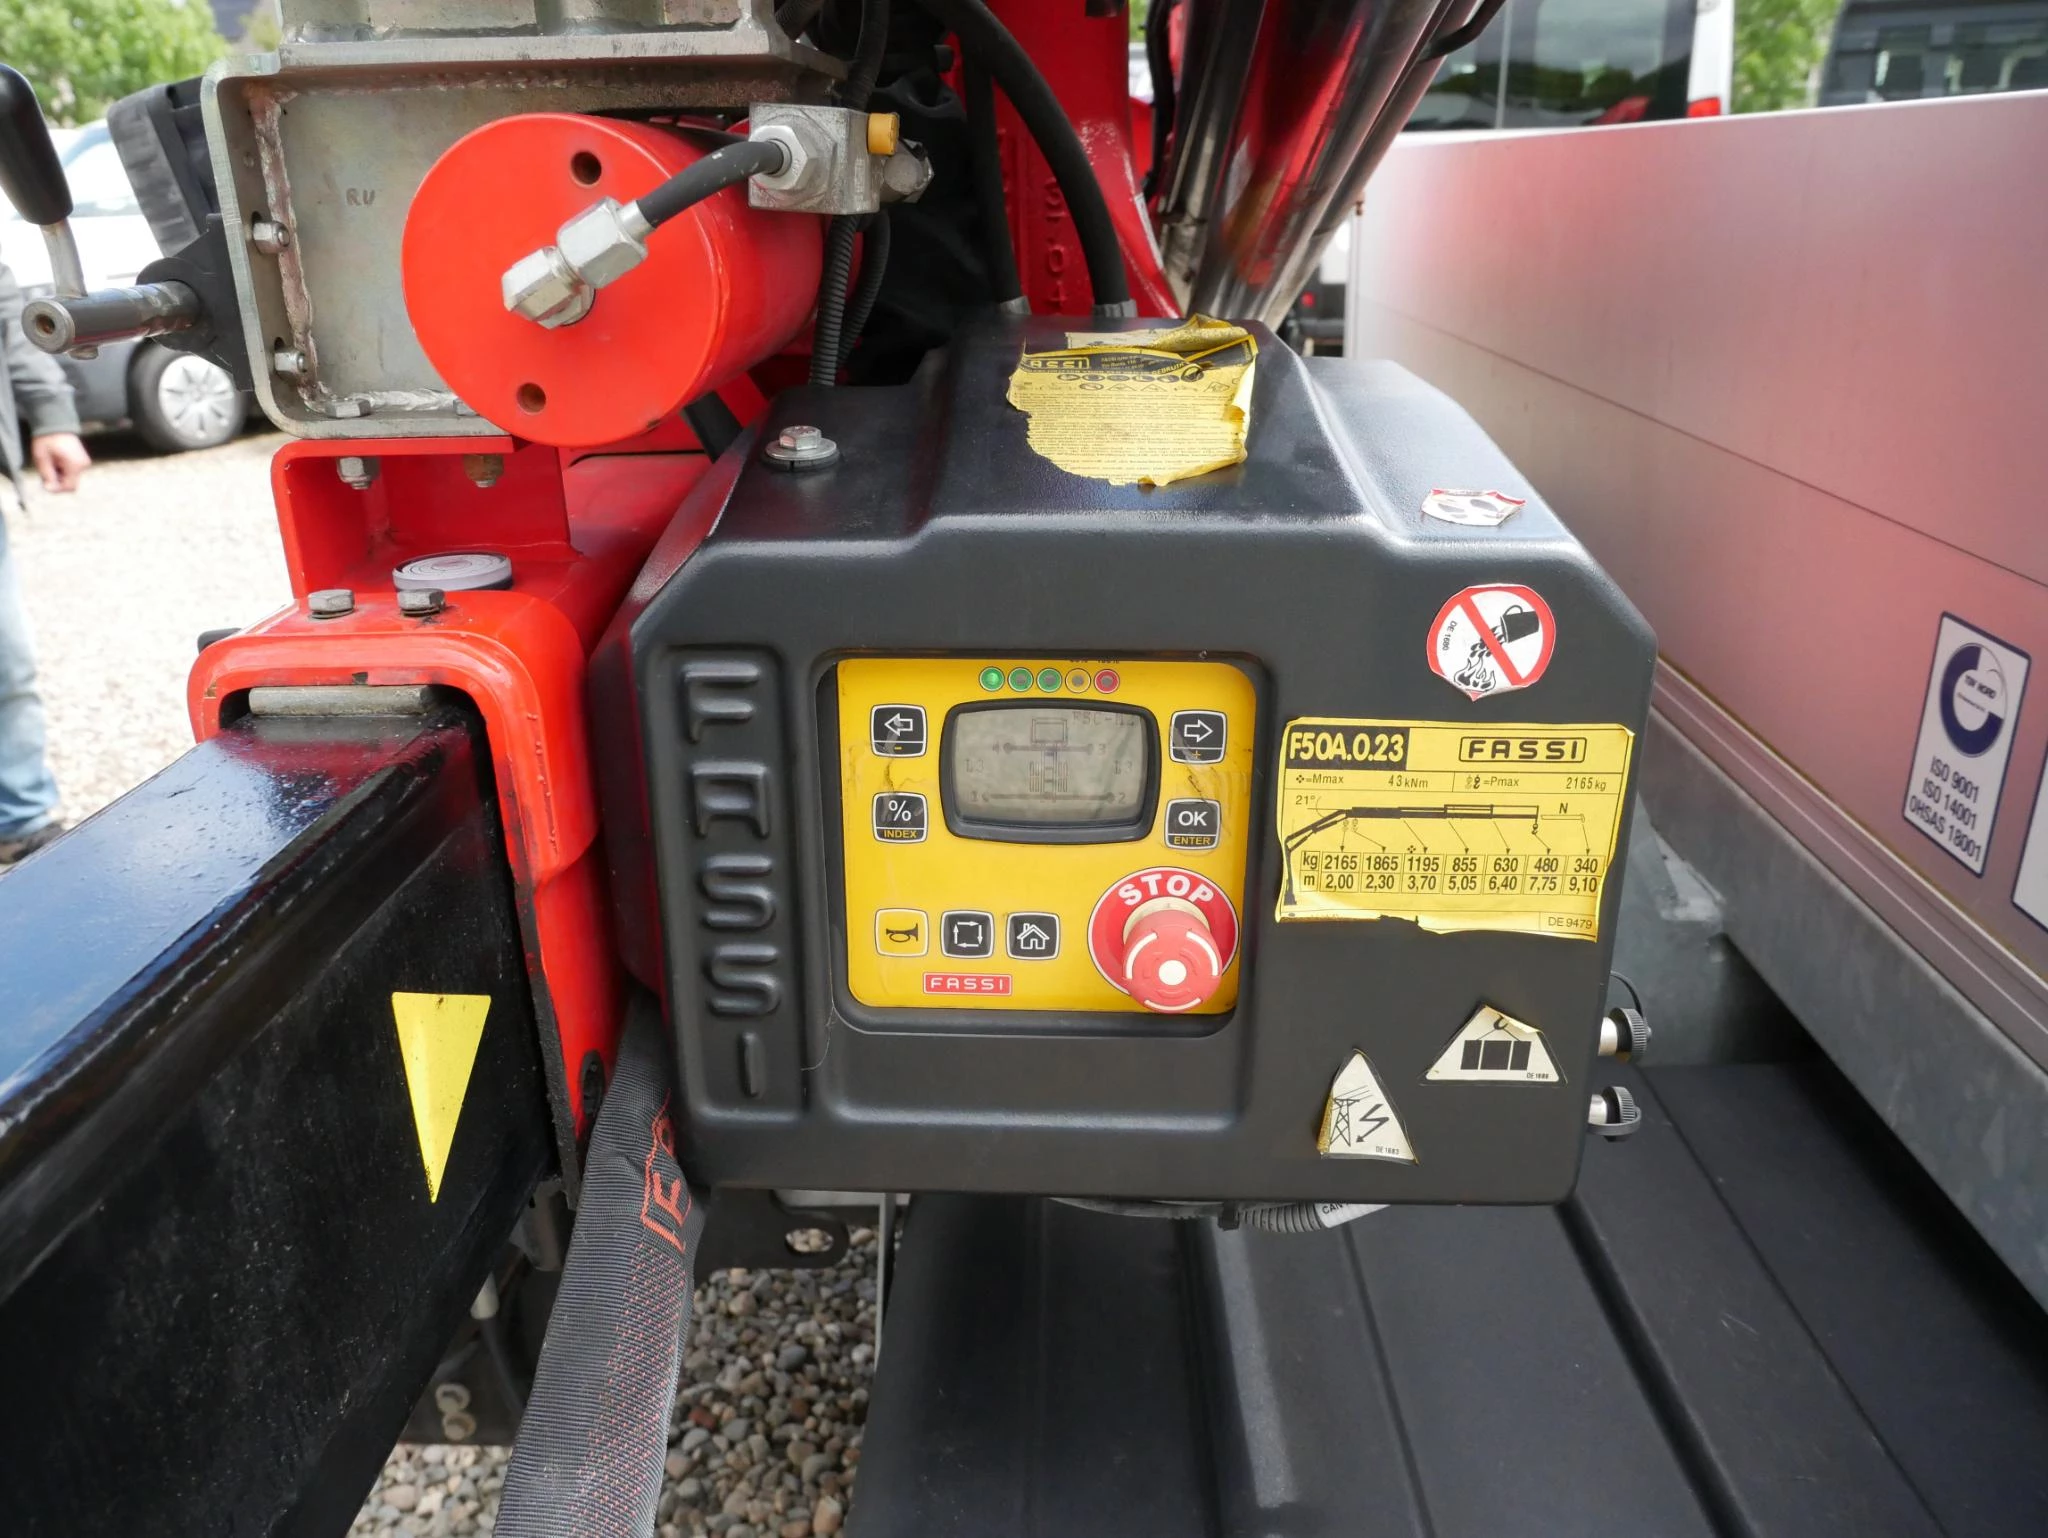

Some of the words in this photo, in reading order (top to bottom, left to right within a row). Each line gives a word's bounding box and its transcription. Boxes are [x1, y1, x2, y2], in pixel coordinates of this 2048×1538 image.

[1024, 359, 1083, 369] ASSI
[1446, 620, 1459, 633] DE
[1289, 731, 1405, 763] F50A.0.23
[1468, 740, 1578, 760] FASSI
[1930, 755, 1950, 782] ISO
[1951, 771, 1979, 803] 9001
[888, 800, 912, 822] %
[1559, 803, 1568, 814] N
[1922, 777, 1941, 804] ISO
[1944, 794, 1977, 830] 14001
[1178, 811, 1207, 827] OK
[1909, 795, 1946, 834] OHSAS
[1948, 825, 1981, 862] 18001
[883, 829, 917, 839] INDEX
[1173, 836, 1211, 846] ENTER
[1303, 851, 1318, 870] kg
[1324, 854, 1358, 870] 2165
[1366, 855, 1399, 871] 1865
[1408, 856, 1440, 872] 1195
[1452, 857, 1477, 872] 855
[1493, 858, 1518, 873] 630
[1534, 858, 1559, 873] 480
[1574, 858, 1598, 873] 340
[681, 657, 782, 1098] FASSI
[1303, 875, 1315, 886] m
[1325, 874, 1354, 890] 2,00
[1366, 874, 1394, 891] 2,30
[1407, 875, 1436, 892] 3,70
[1448, 875, 1477, 894] 5,05
[1488, 876, 1518, 893] 6,40
[1529, 876, 1557, 892] 7,75
[1569, 876, 1598, 893] 9,10
[1118, 874, 1214, 906] STOP
[1548, 917, 1564, 927] DE
[1566, 917, 1592, 929] 9479
[930, 977, 1005, 991] FASSI
